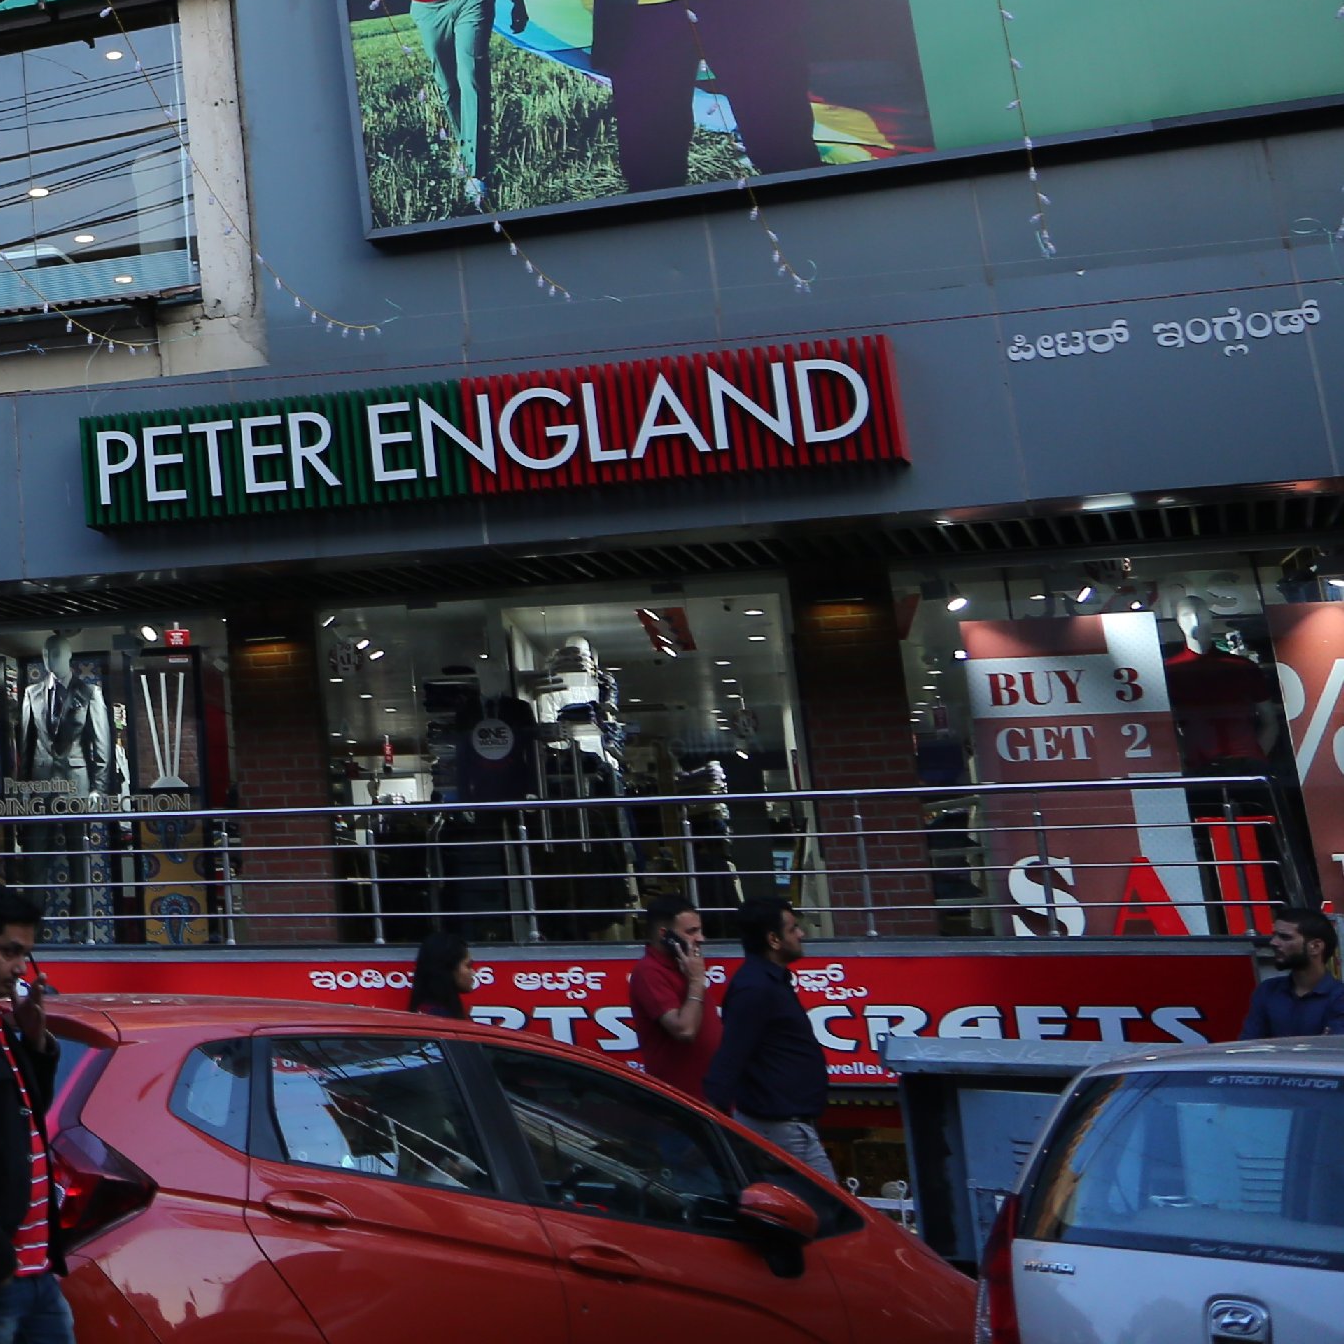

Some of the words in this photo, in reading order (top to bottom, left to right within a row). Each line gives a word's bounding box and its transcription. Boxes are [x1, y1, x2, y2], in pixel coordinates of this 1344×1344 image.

[95, 411, 343, 506] PETER
[366, 358, 871, 483] ENGLAND
[988, 669, 1085, 707] BUY
[1114, 667, 1144, 703] 3
[996, 724, 1095, 763] GET
[1120, 723, 1152, 758] 2
[3, 776, 78, 794] Presenting
[51, 793, 191, 815] COLLECTION
[470, 1006, 641, 1051] RTS
[1228, 1075, 1279, 1085] TRIDENT
[1280, 1077, 1339, 1089] HYUNDAI
